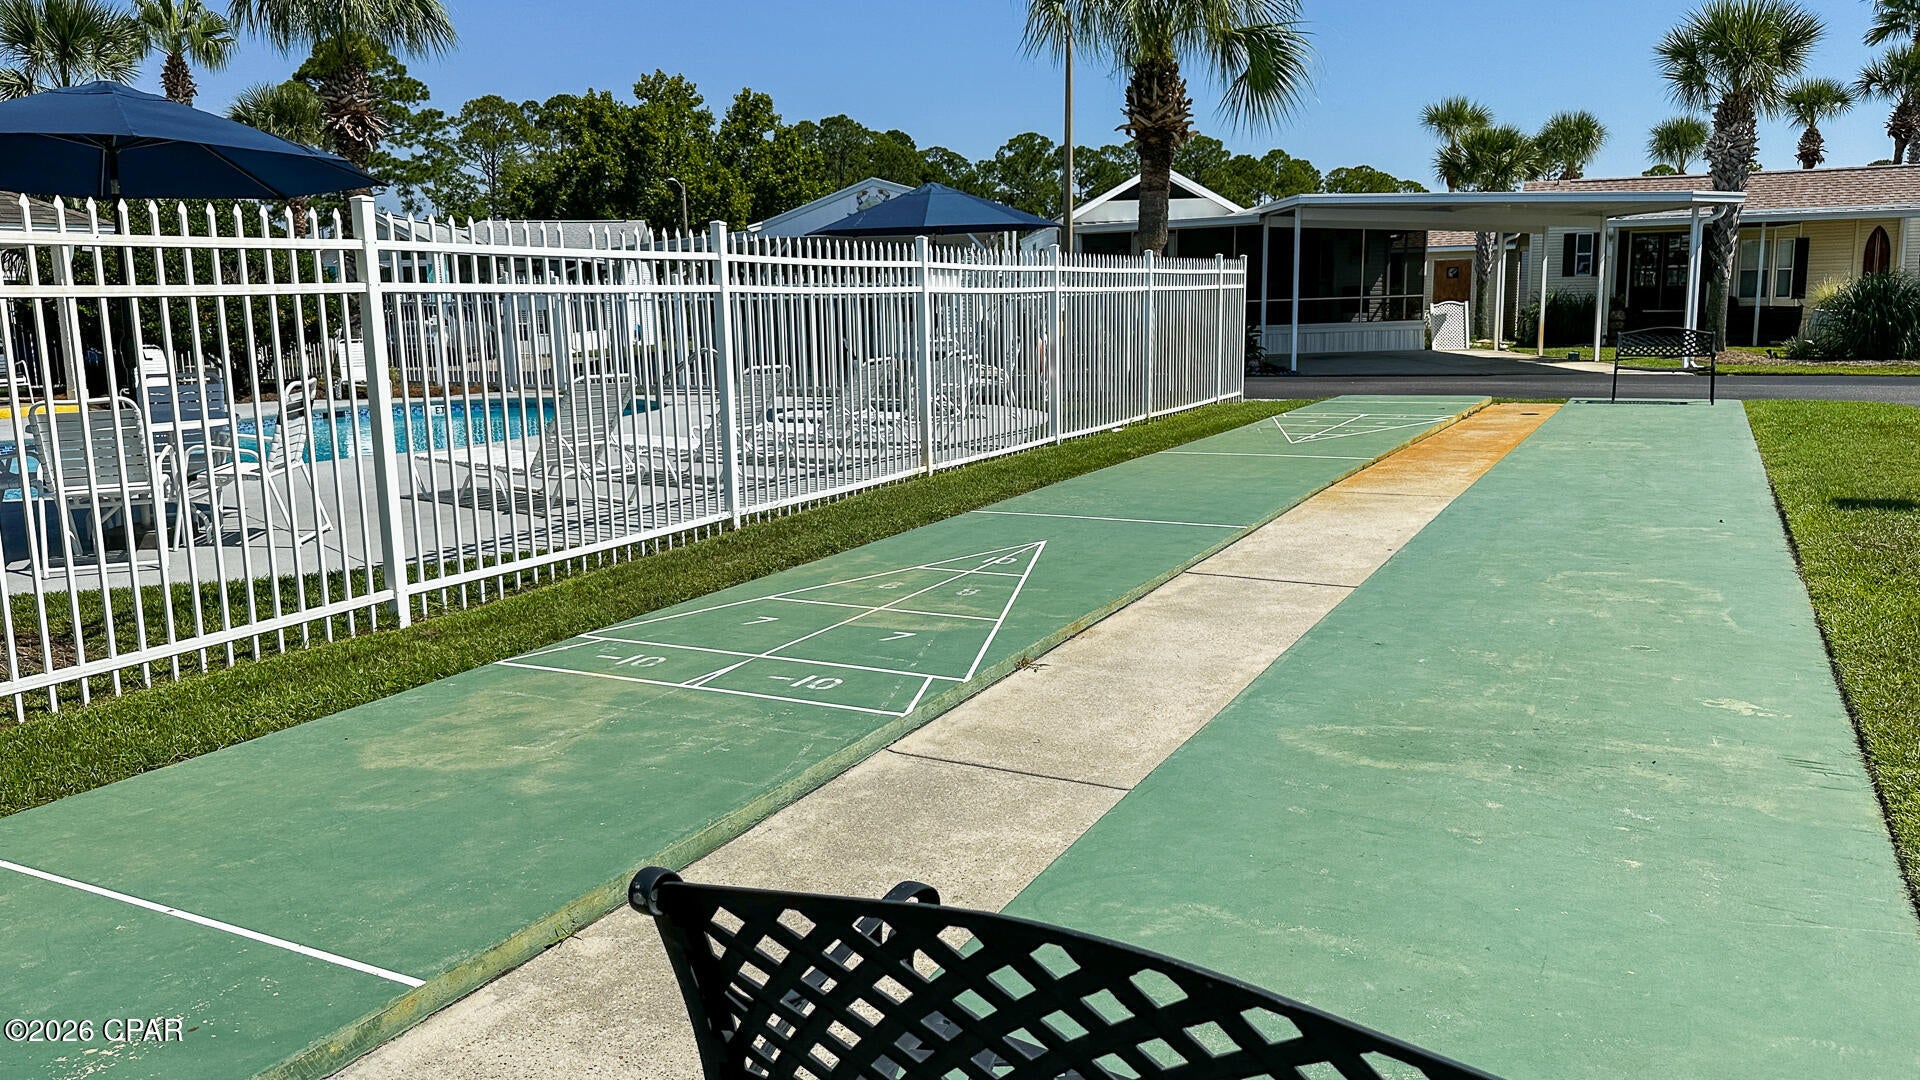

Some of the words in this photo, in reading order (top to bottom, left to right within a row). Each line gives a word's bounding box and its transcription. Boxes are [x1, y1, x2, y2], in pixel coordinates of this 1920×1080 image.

[741, 616, 780, 625] 7
[880, 631, 917, 642] 7
[595, 654, 667, 668] -10
[767, 674, 844, 690] -10
